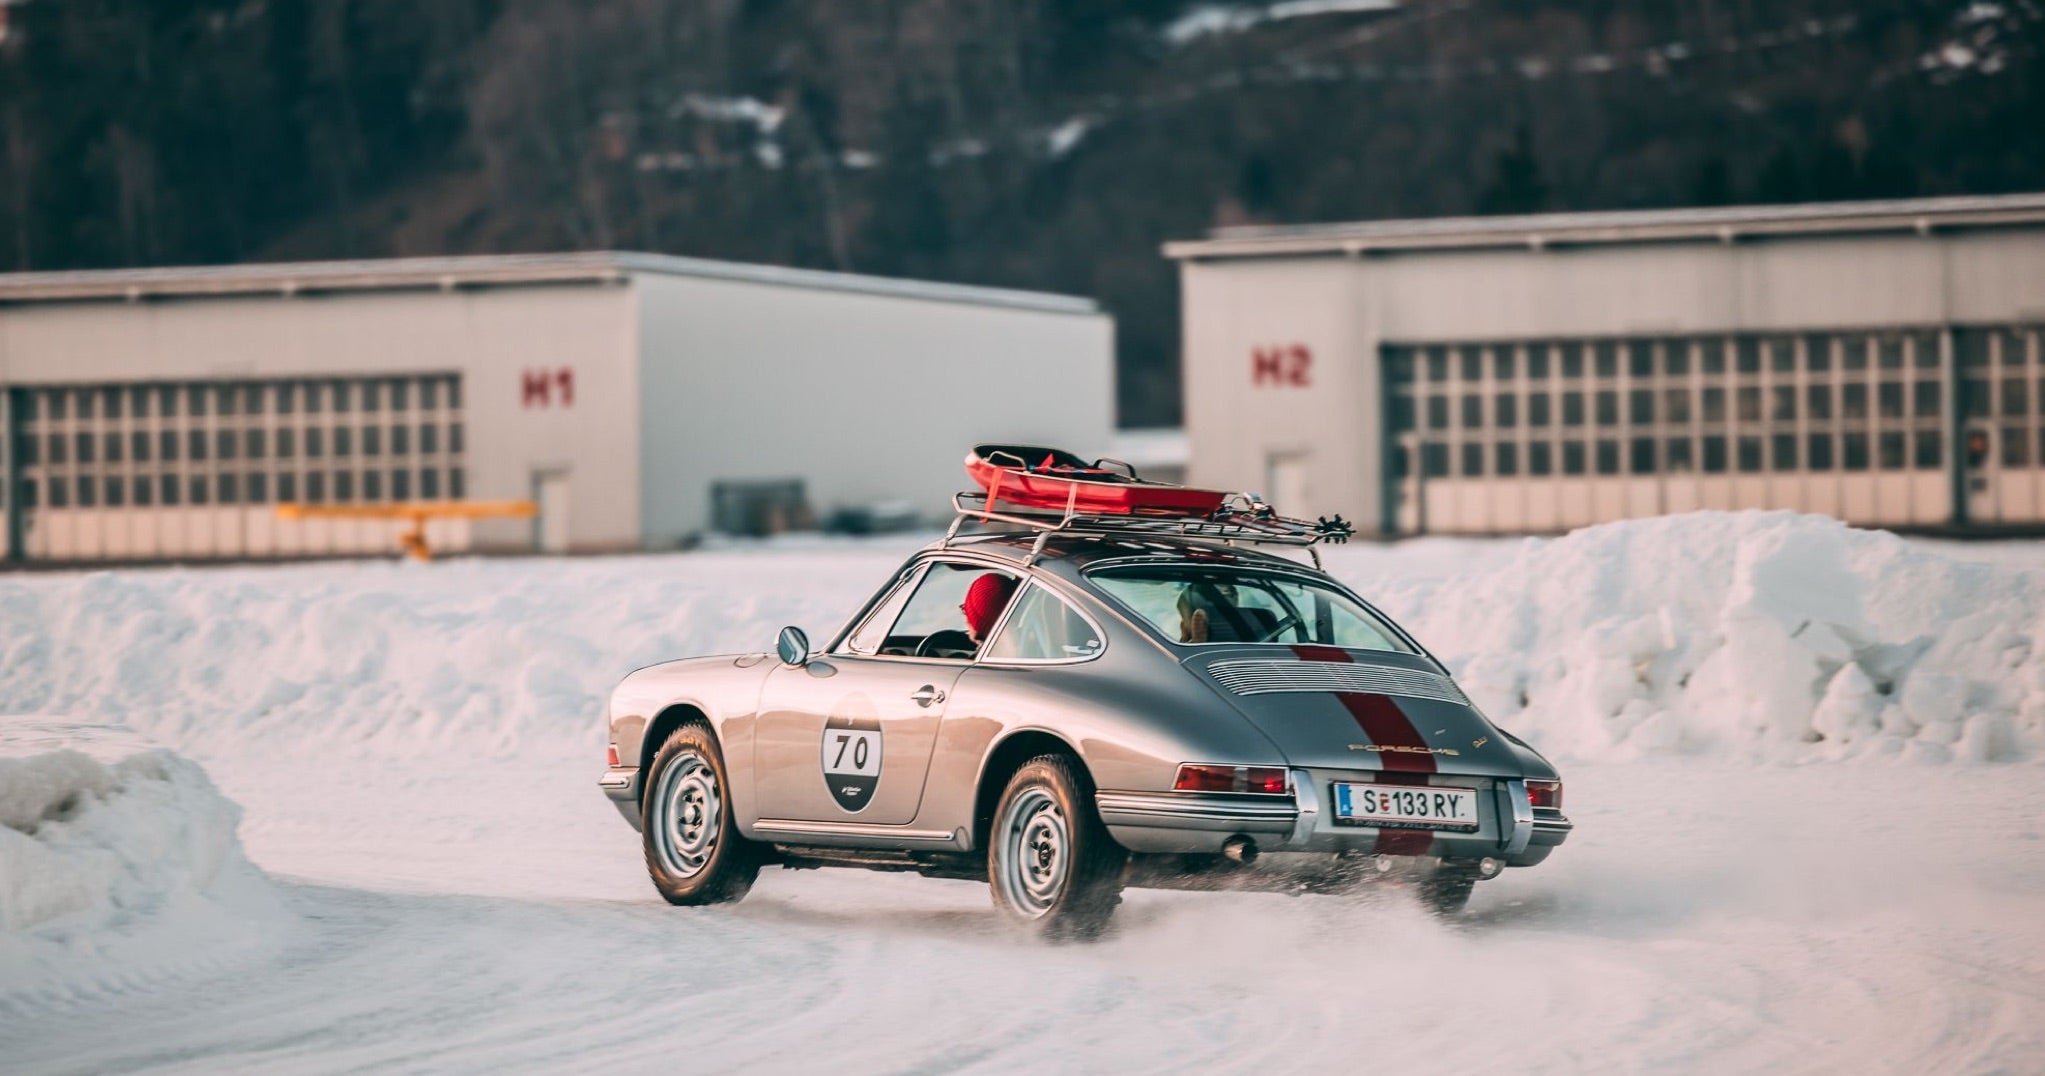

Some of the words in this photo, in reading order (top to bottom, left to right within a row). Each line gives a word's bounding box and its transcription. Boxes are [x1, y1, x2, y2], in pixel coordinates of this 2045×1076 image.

[1252, 344, 1312, 388] H2
[521, 368, 574, 408] H1
[833, 735, 868, 769] 70
[1348, 744, 1460, 756] PORSCHE
[1364, 790, 1376, 813] S
[1392, 791, 1428, 816] 133
[1434, 793, 1459, 818] RY
